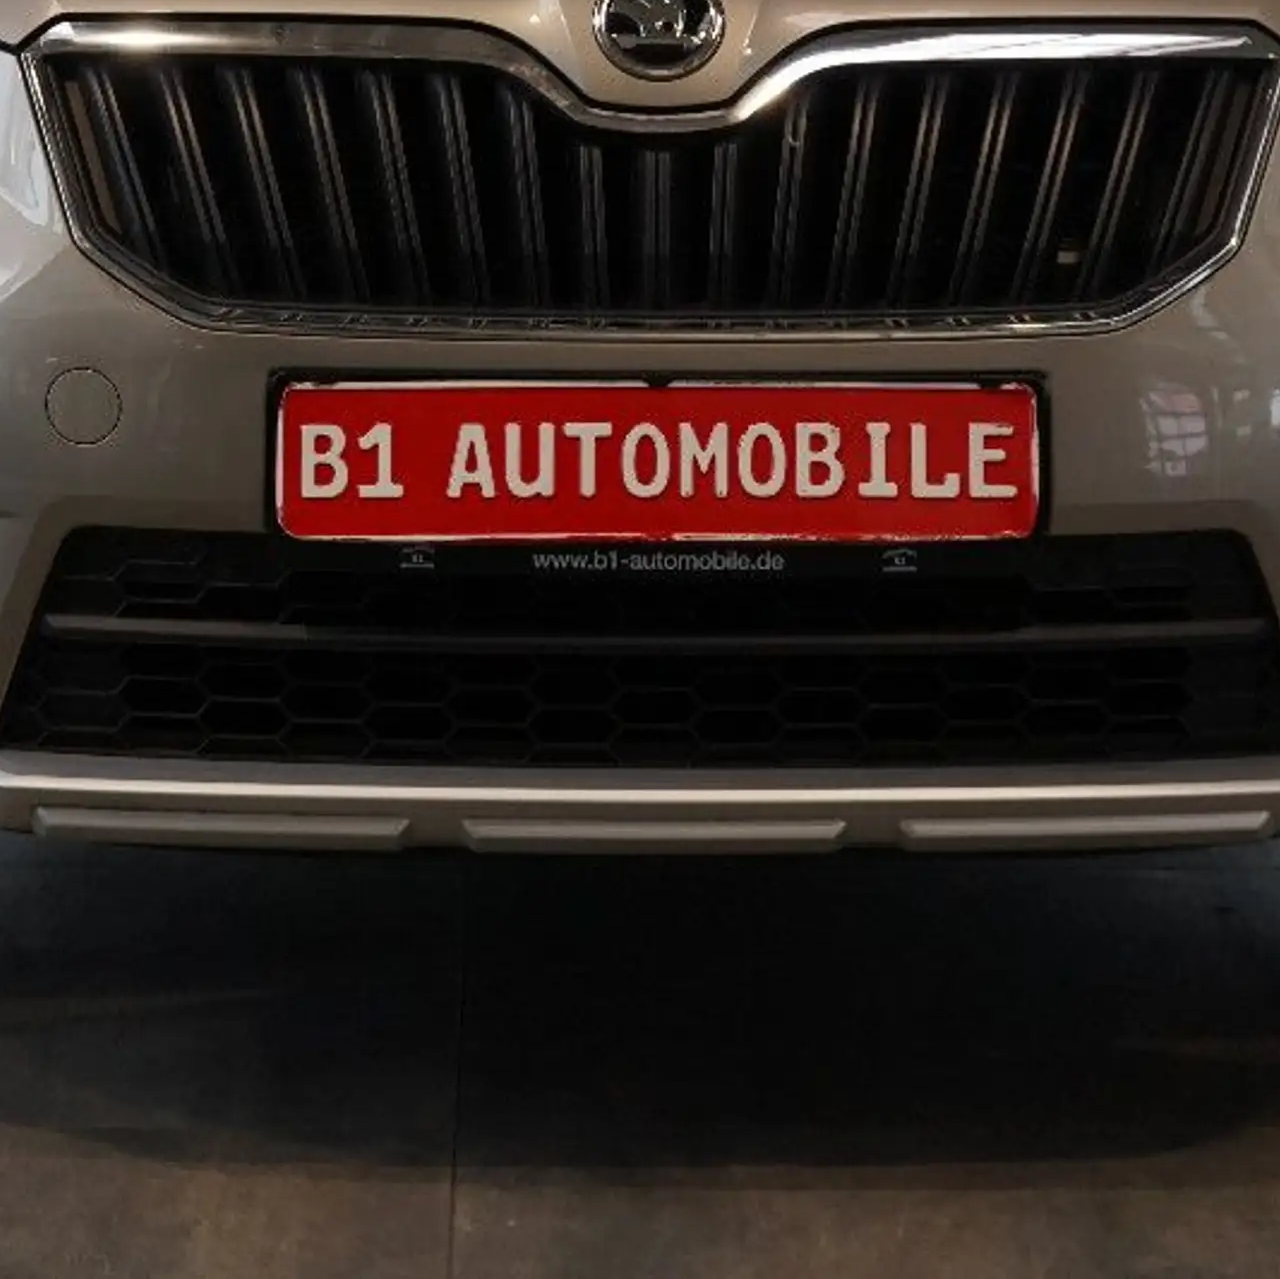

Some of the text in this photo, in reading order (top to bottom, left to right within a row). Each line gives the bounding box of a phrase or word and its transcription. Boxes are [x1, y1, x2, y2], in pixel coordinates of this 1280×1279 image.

[299, 421, 1019, 499] B1 AUTOMOBILE
[532, 550, 786, 571] www.b1-automobile.de
